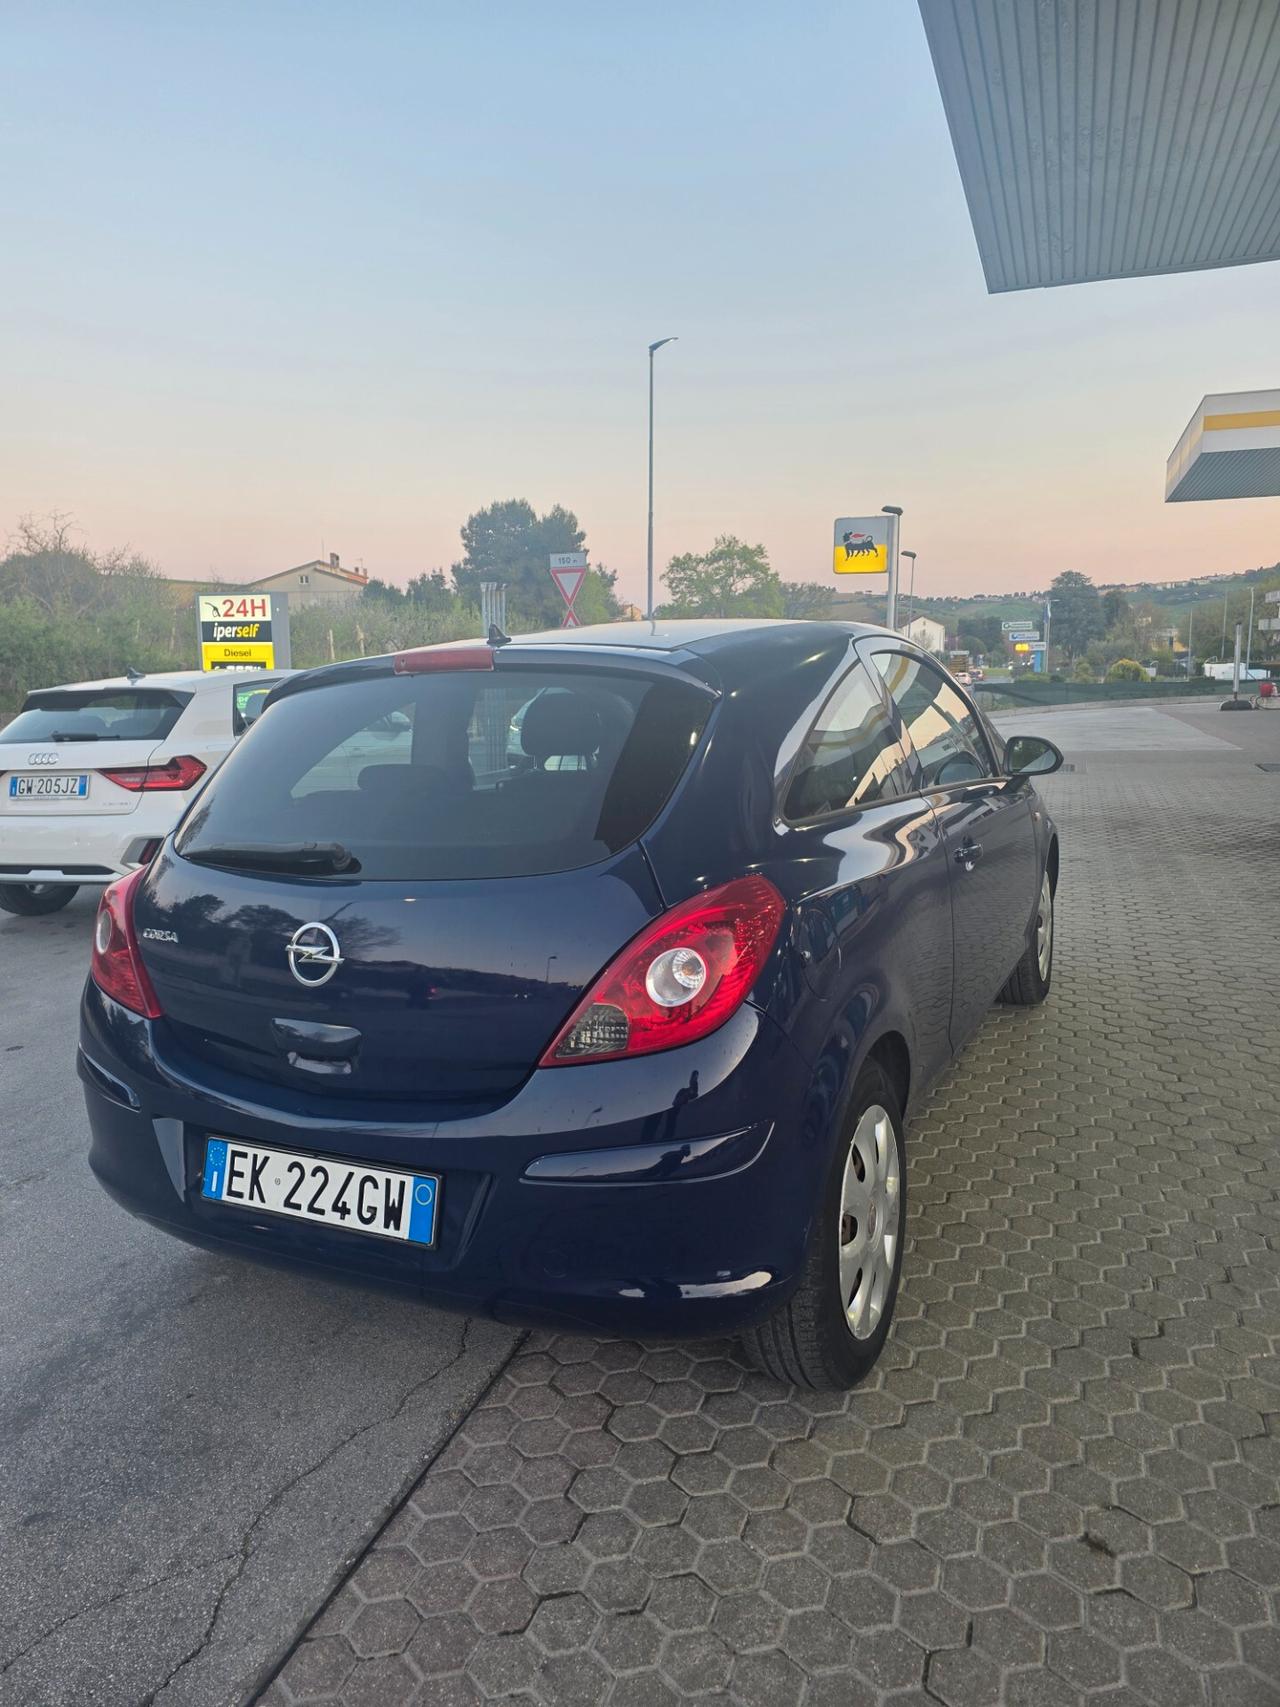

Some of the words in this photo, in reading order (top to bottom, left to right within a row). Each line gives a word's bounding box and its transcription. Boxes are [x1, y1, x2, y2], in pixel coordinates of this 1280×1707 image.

[222, 598, 266, 617] 24H
[213, 622, 260, 641] iperself
[223, 648, 252, 657] Diesel
[18, 778, 33, 794] GW
[37, 778, 78, 794] 205JZ
[226, 1150, 270, 1204] EK
[283, 1161, 406, 1232] 224GW
